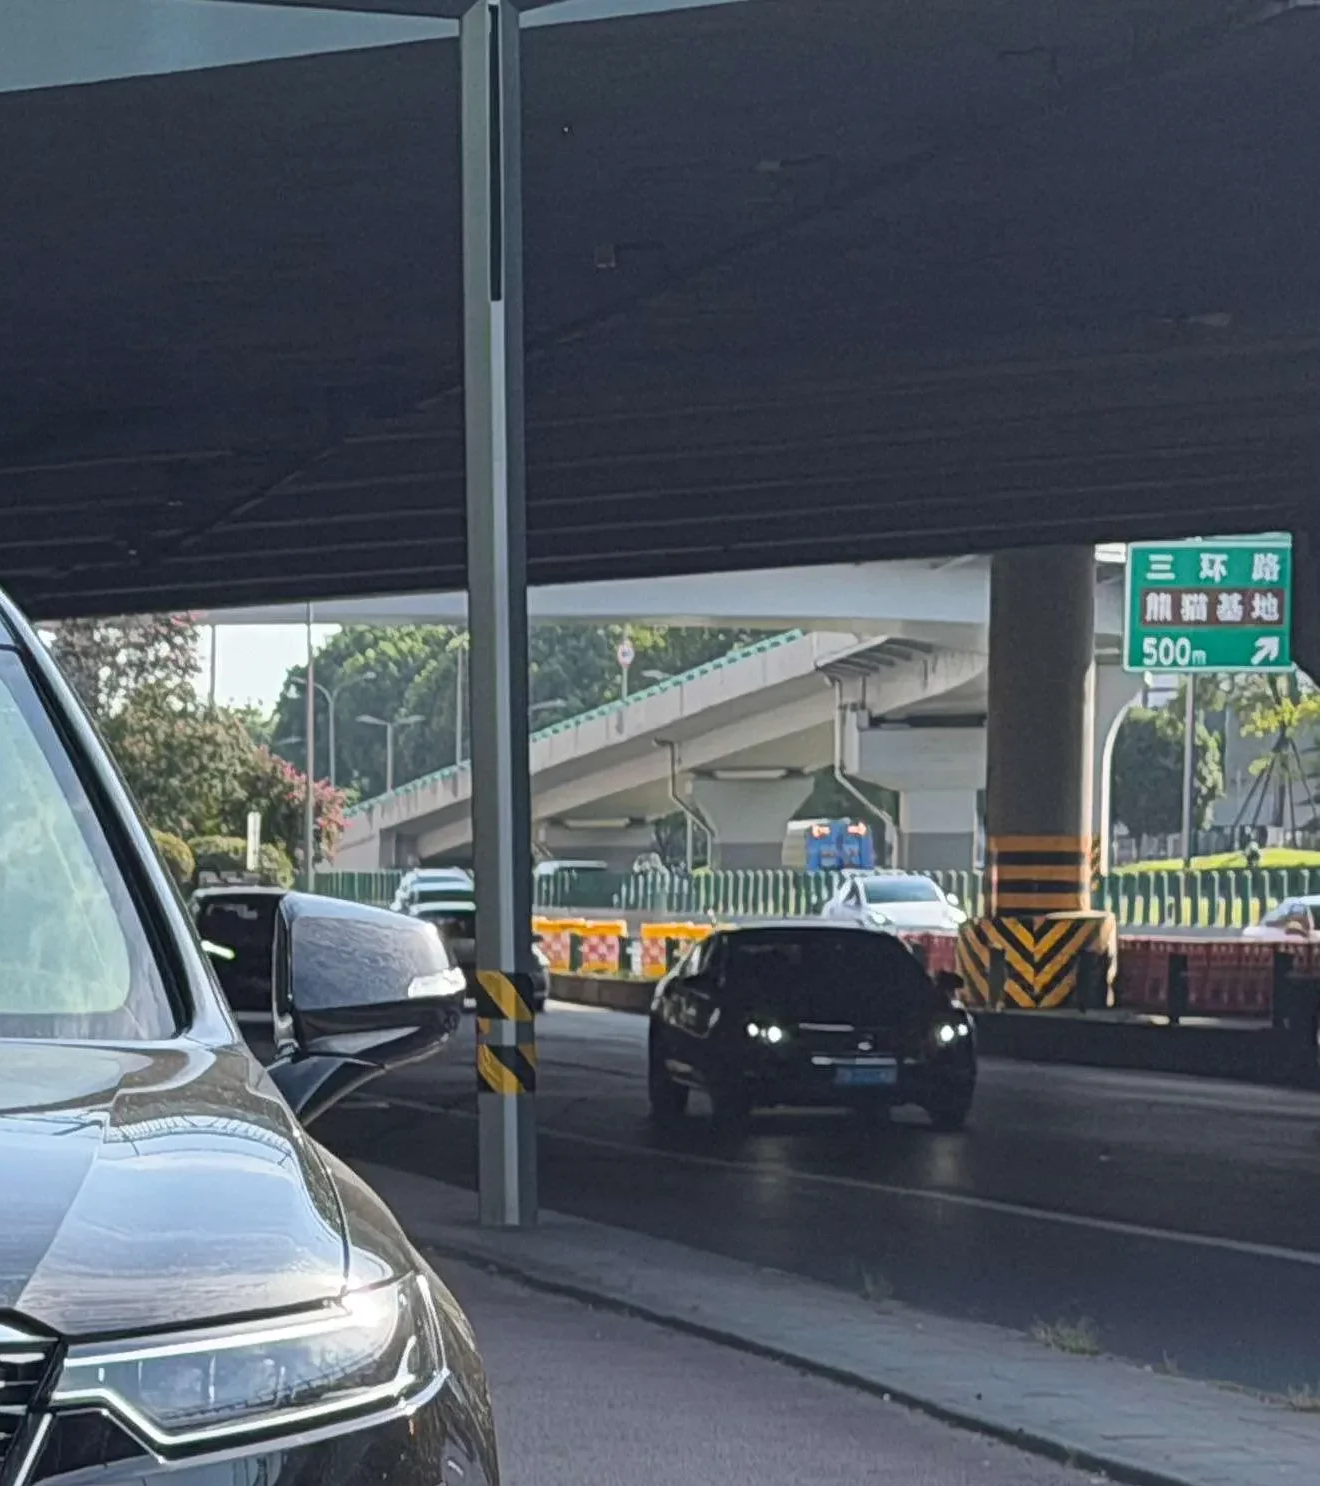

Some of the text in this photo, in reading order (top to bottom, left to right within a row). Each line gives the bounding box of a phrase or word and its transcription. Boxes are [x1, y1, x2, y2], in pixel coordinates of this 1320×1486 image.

[1146, 552, 1280, 582] 三环路
[1142, 637, 1207, 666] 500m
